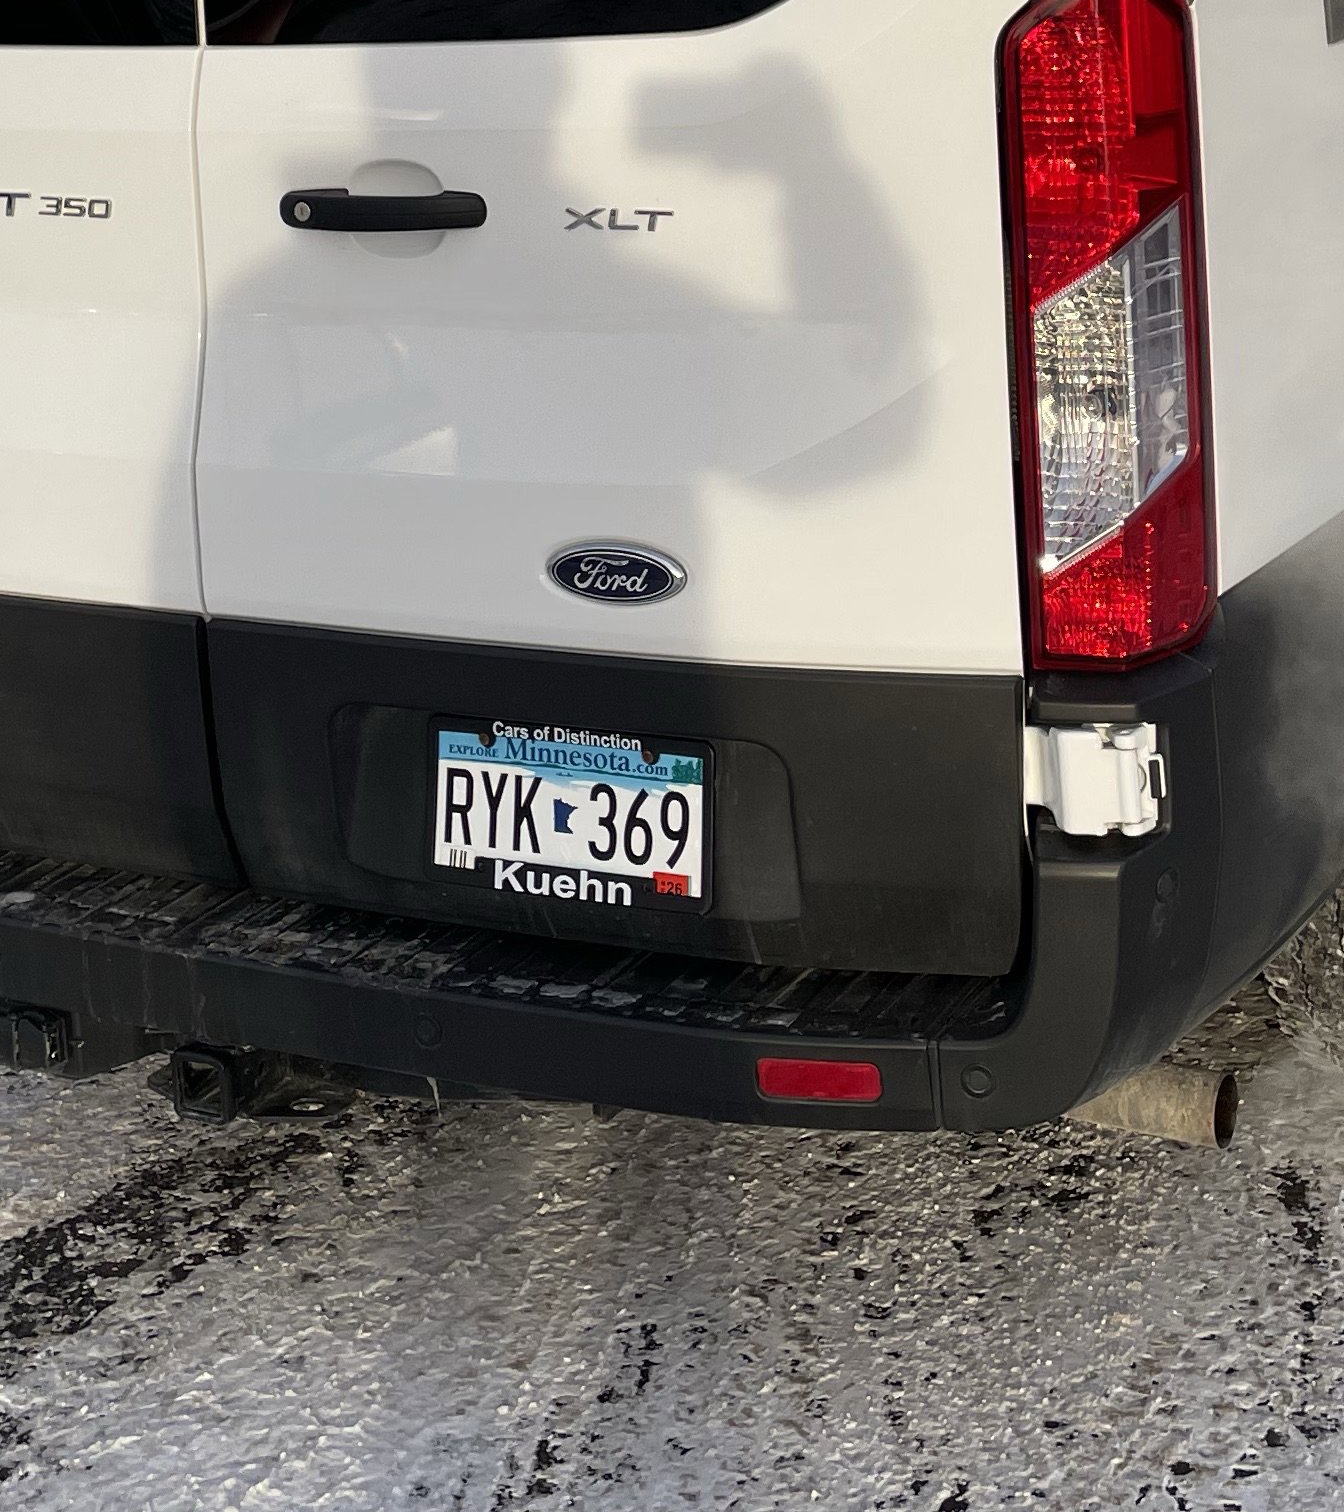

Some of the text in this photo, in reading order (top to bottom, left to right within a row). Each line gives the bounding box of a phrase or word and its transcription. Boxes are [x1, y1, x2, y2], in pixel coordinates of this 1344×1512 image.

[38, 195, 113, 219] 350
[563, 208, 674, 232] XLT
[574, 556, 649, 592] Ford
[492, 721, 642, 752] Cars of Distinction
[448, 744, 499, 758] EXPLORE
[494, 860, 632, 907] Kuehn
